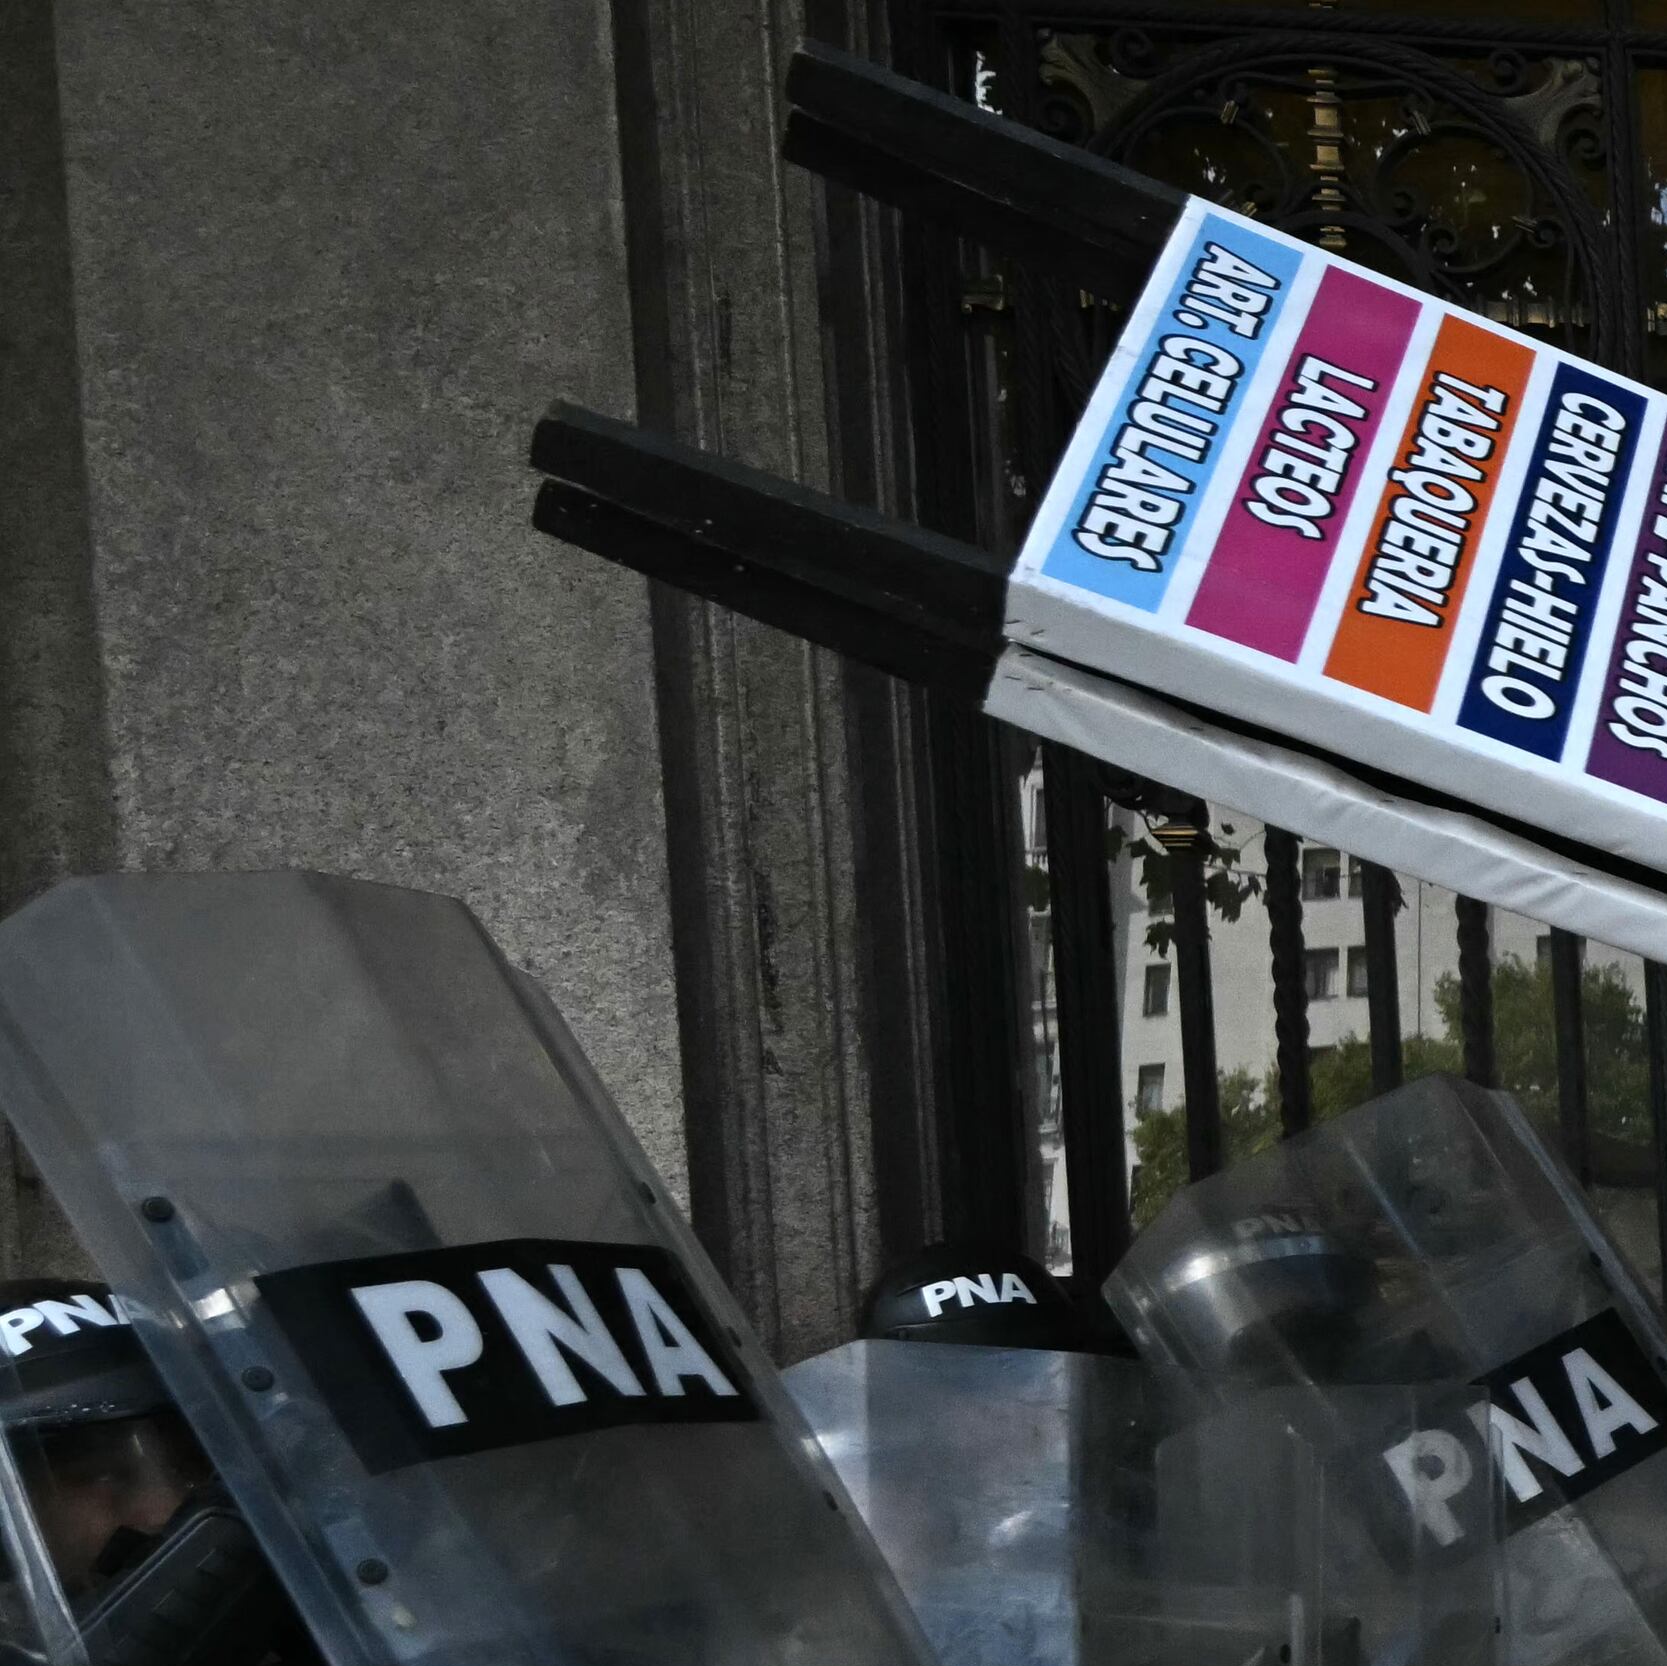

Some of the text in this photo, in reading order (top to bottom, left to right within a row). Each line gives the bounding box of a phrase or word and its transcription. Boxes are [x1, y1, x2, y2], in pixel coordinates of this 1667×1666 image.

[1070, 241, 1282, 574] ART. CELULARES
[1245, 353, 1380, 541] LACTEOS
[1357, 370, 1507, 628] TABAQUERIA
[1479, 391, 1628, 721] CERVEZAS-HIELO
[349, 1264, 741, 1430] PNA
[923, 1273, 1037, 1318] PNA
[1384, 1347, 1659, 1548] PNA
